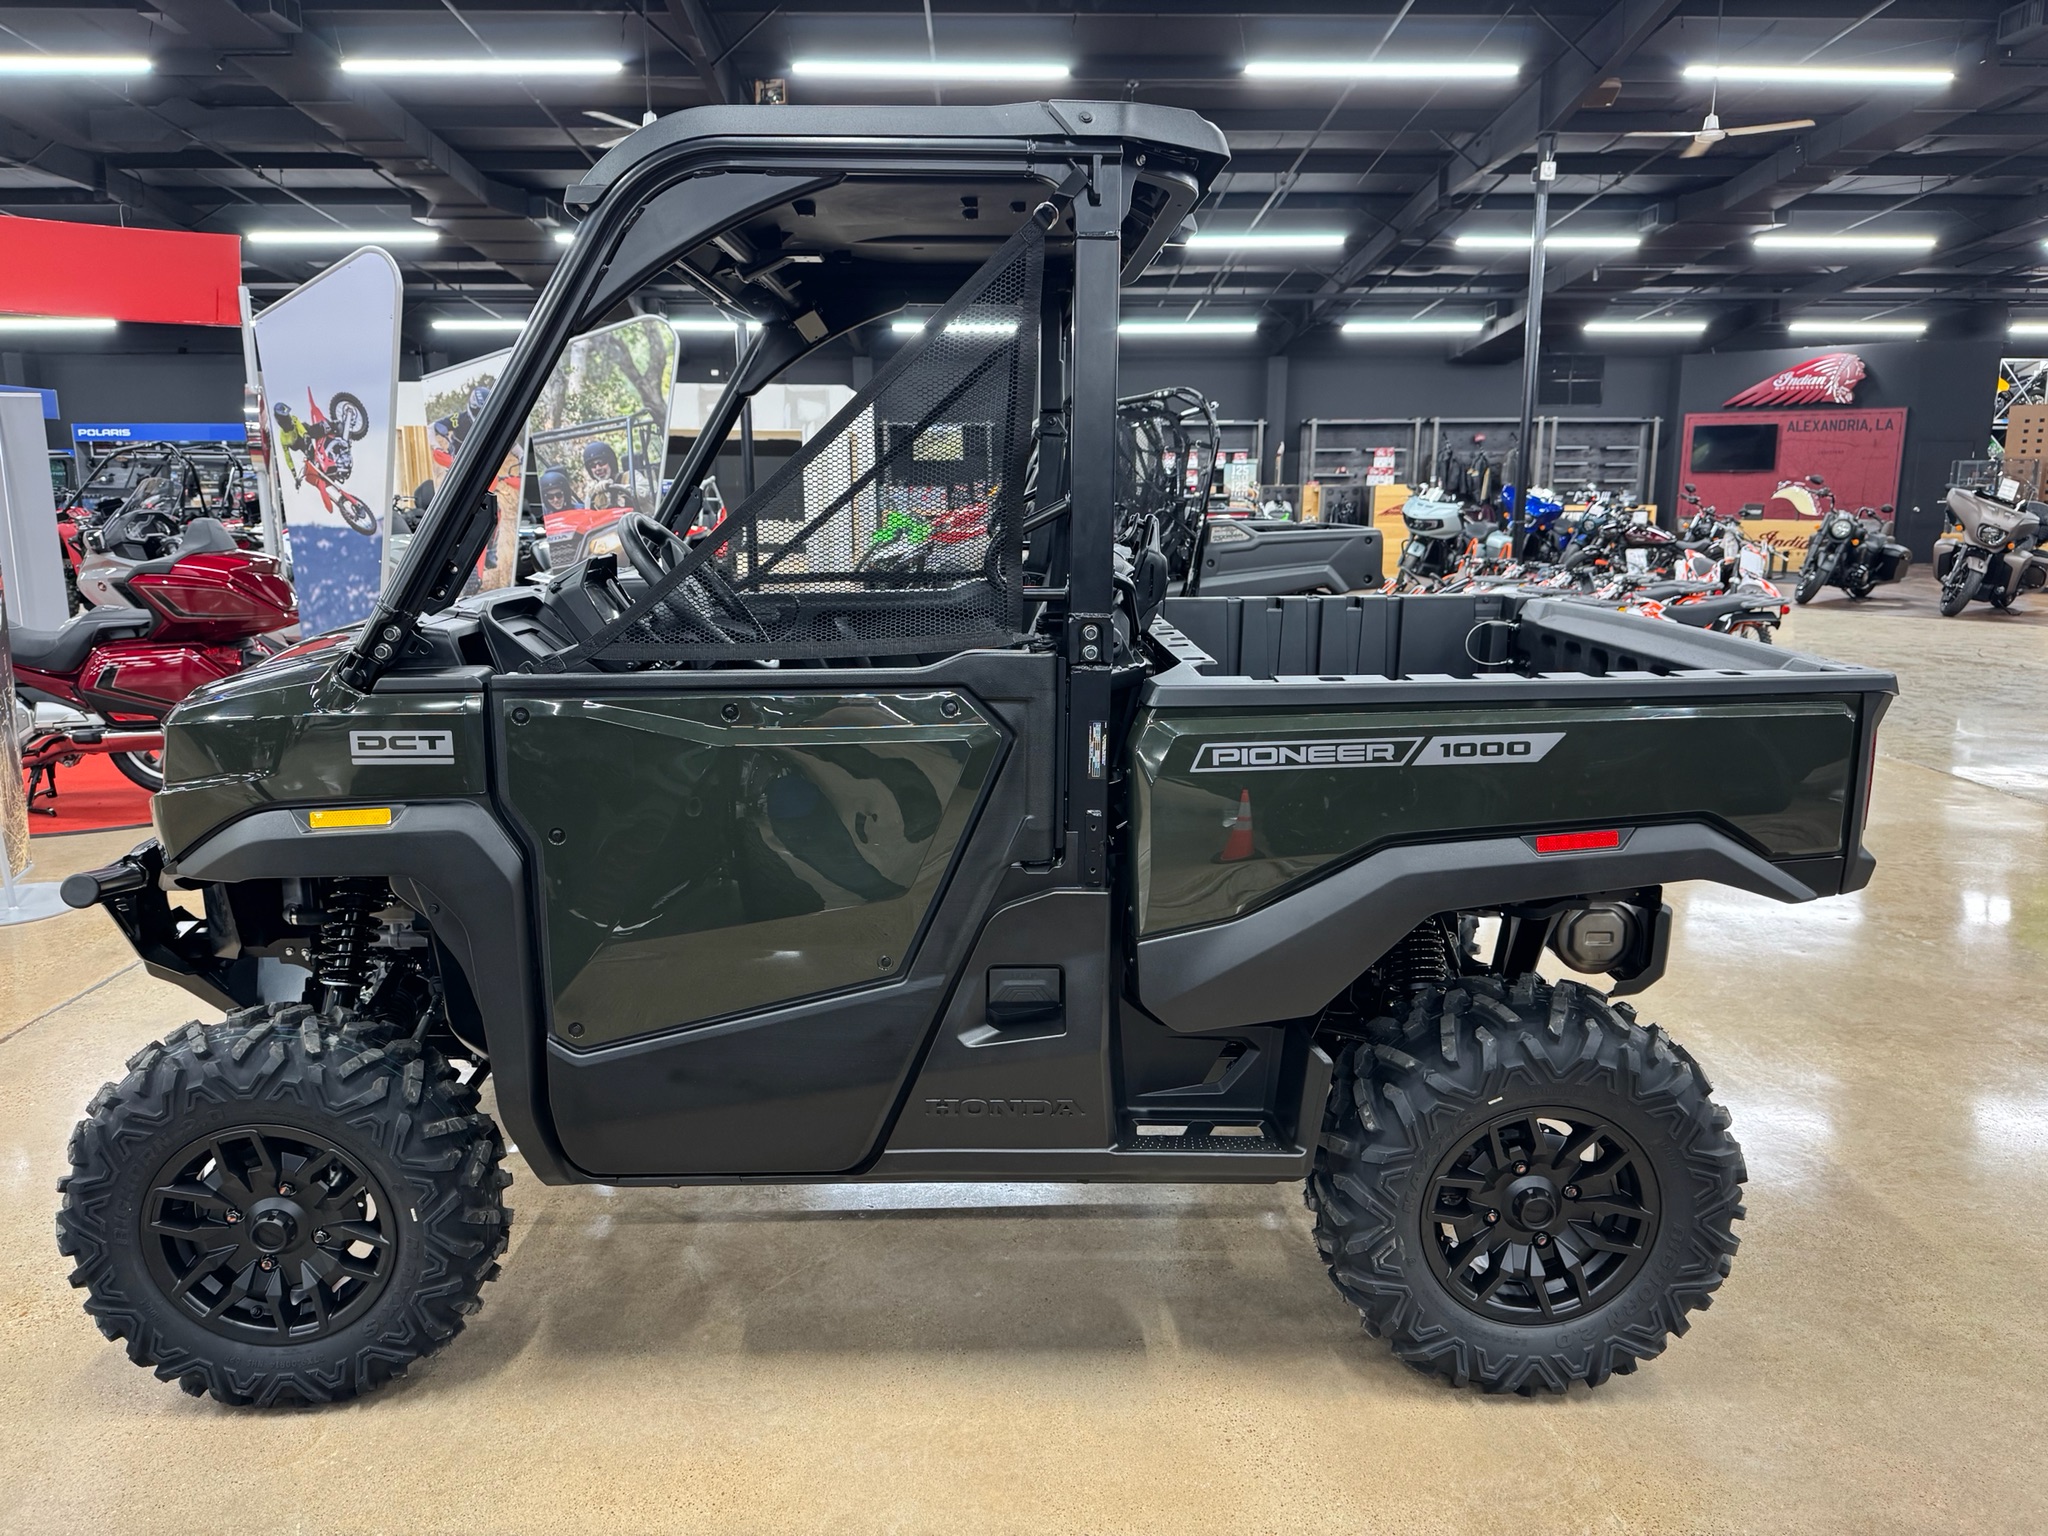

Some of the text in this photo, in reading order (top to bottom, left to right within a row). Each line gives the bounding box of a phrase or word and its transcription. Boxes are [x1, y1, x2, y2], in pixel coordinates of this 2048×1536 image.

[1773, 371, 1827, 387] Indian
[77, 428, 131, 437] POLARIS
[1787, 418, 1894, 432] ALEXANDRIA, LA
[1231, 465, 1249, 475] 125
[1759, 530, 1809, 549] India
[357, 735, 445, 750] DCT
[1212, 741, 1531, 766] PIONEER 1000
[925, 1099, 1086, 1117] HONDA
